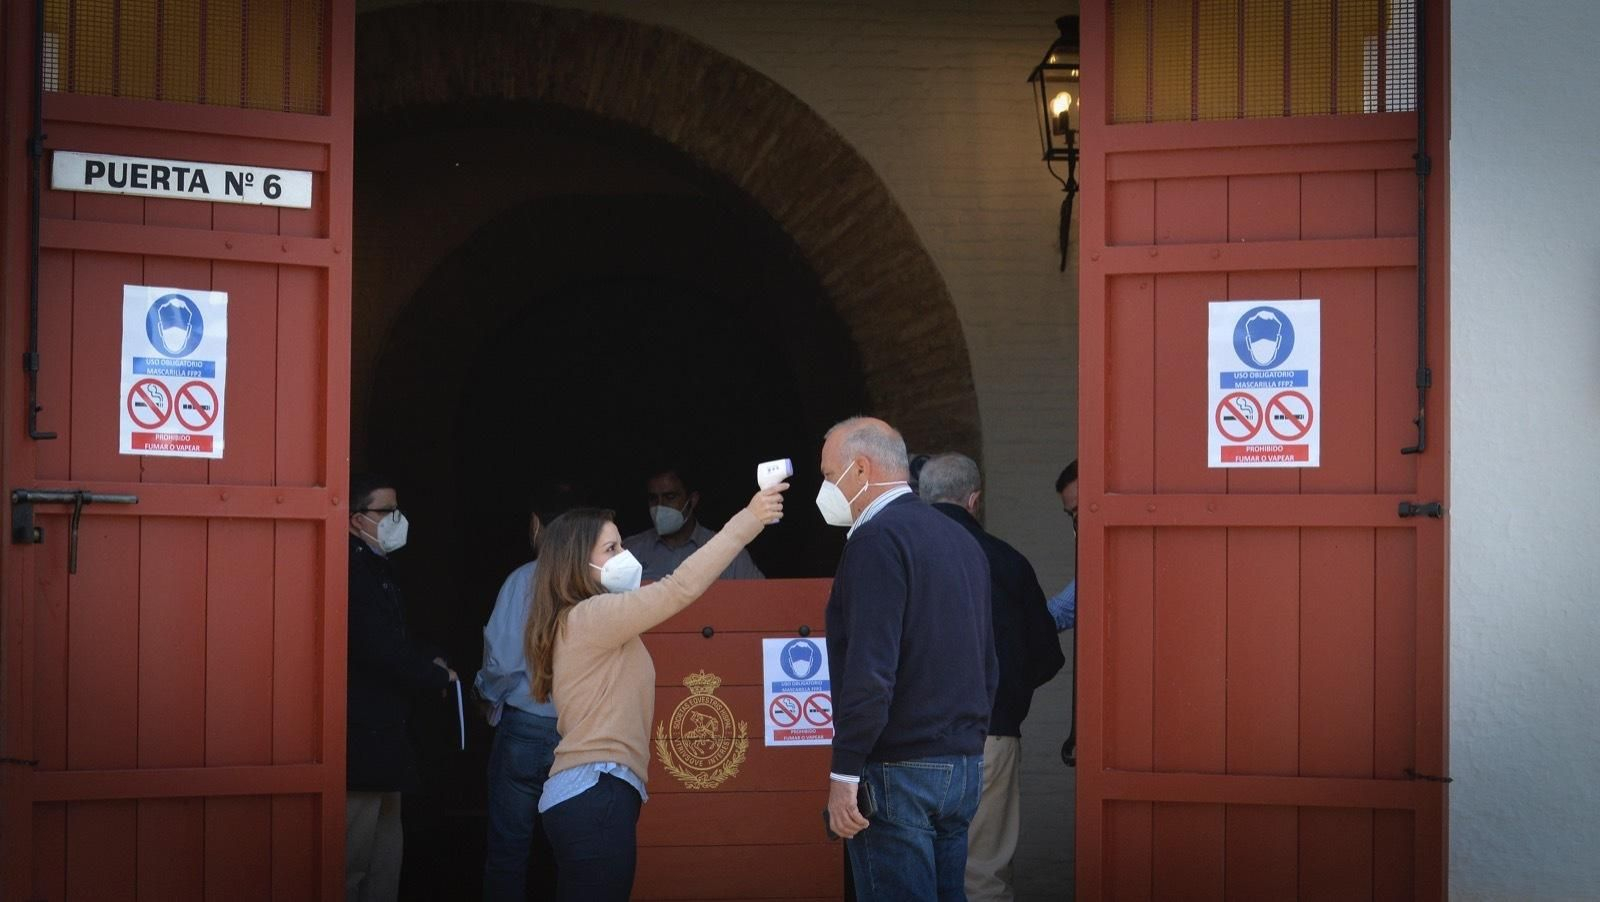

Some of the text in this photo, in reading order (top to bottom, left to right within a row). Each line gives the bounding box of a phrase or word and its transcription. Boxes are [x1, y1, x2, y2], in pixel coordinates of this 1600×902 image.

[85, 160, 282, 199] PUERTA Nº 6
[161, 360, 203, 368] OBLIGATORIO
[146, 368, 186, 377] MASCARILLA
[1250, 371, 1295, 379] OBLIGATORIO
[155, 433, 191, 442] PROHIBIDO
[1246, 445, 1284, 453] PROHIBIDO
